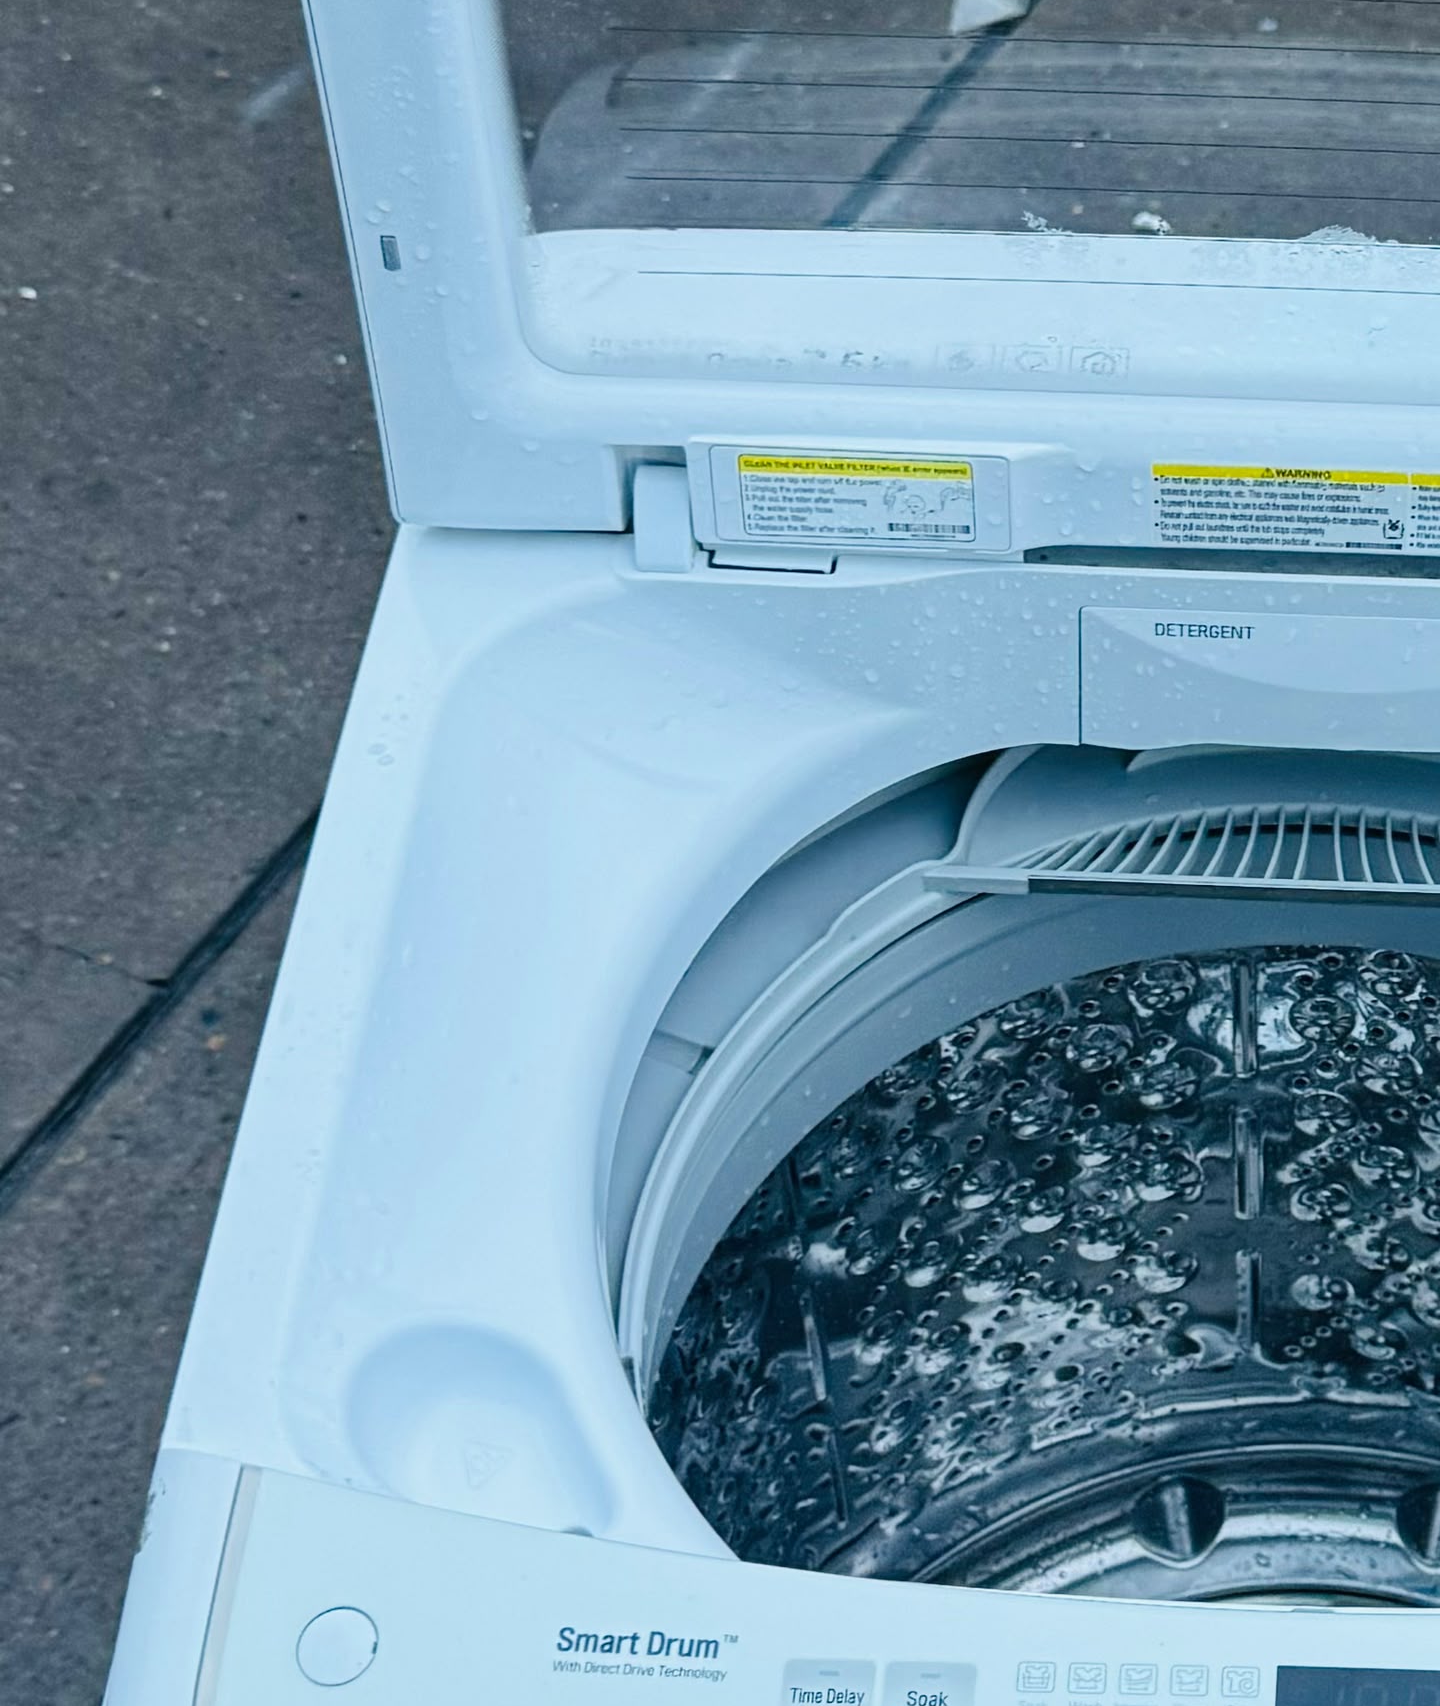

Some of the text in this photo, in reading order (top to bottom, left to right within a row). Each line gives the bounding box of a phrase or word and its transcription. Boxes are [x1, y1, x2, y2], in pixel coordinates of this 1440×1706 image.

[1274, 468, 1331, 480] WARNING
[1154, 622, 1256, 640] DETERGENT
[556, 1626, 641, 1655] Smart
[553, 1660, 728, 1683] With Direct Drive Technology
[789, 1687, 823, 1705] Time
